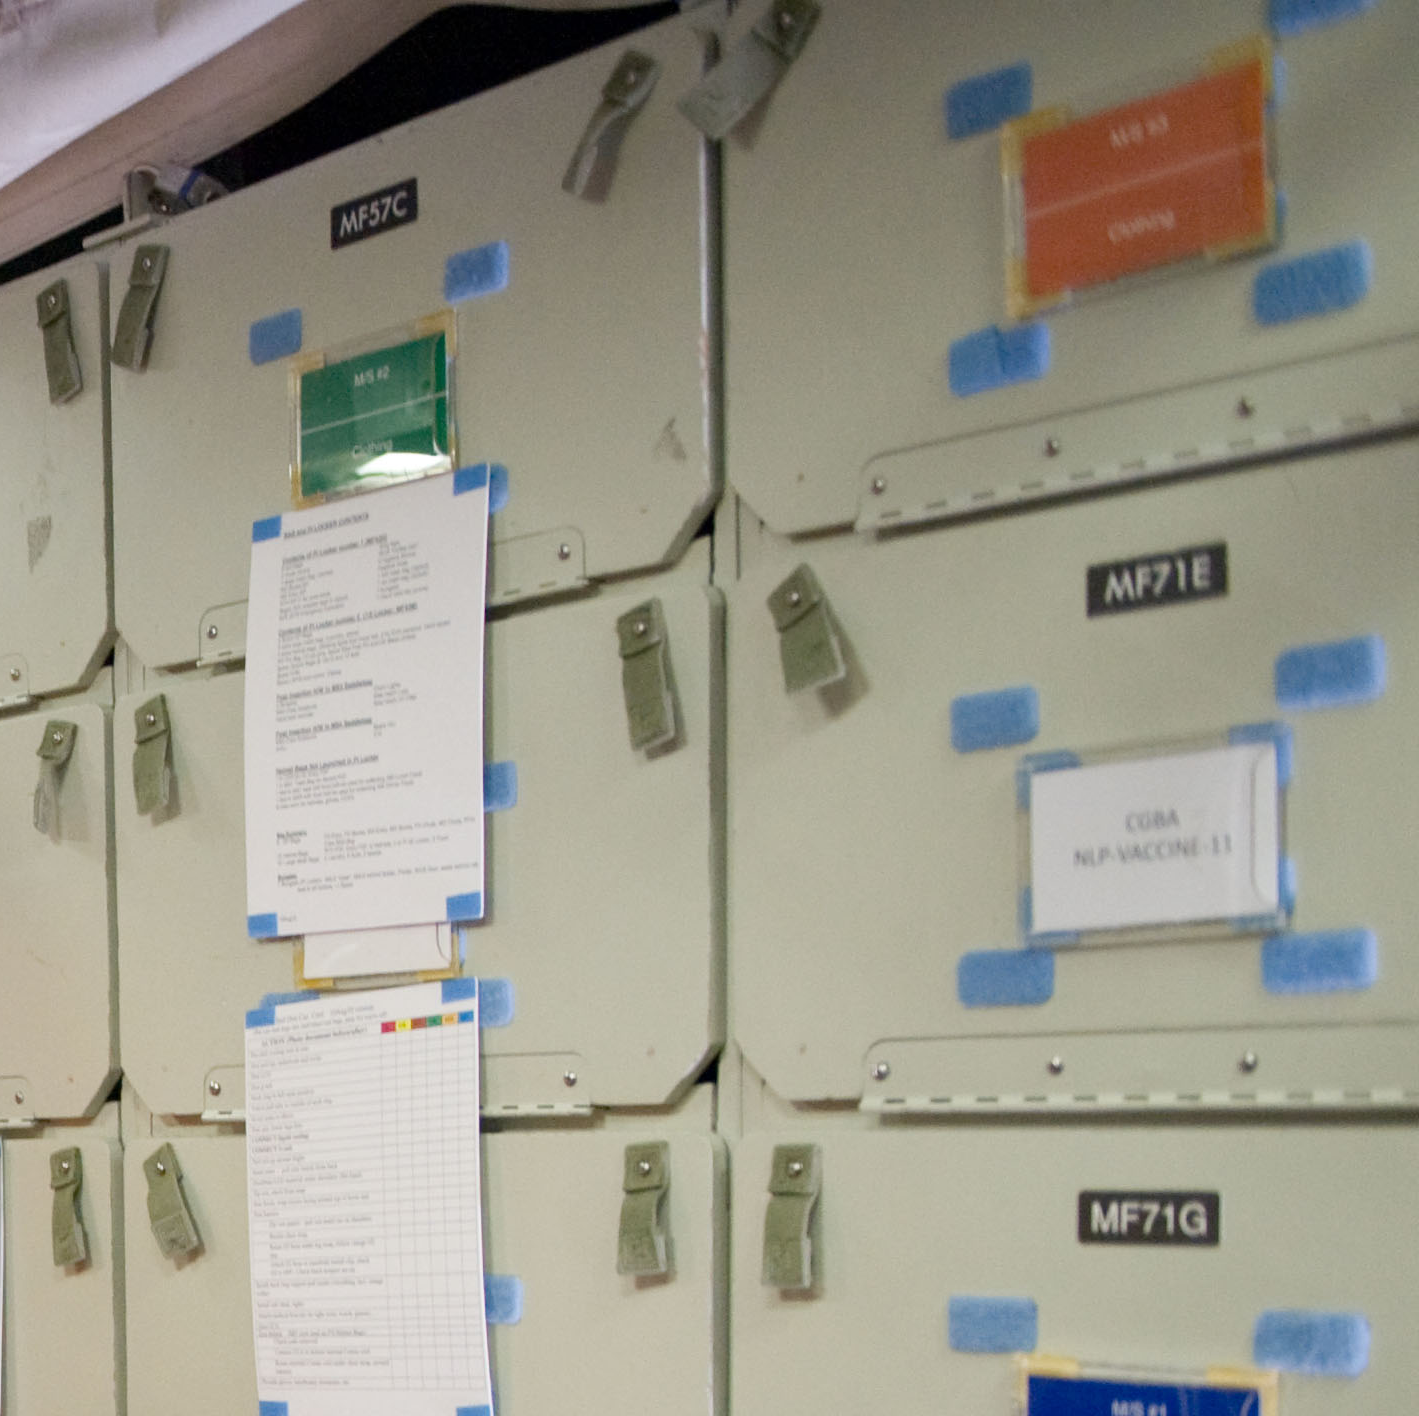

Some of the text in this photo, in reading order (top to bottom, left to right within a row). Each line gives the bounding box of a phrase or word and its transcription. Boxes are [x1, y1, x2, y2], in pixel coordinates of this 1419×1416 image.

[339, 190, 408, 238] MF57C
[1103, 552, 1211, 606] MF71E
[1089, 1200, 1208, 1238] MF71G
